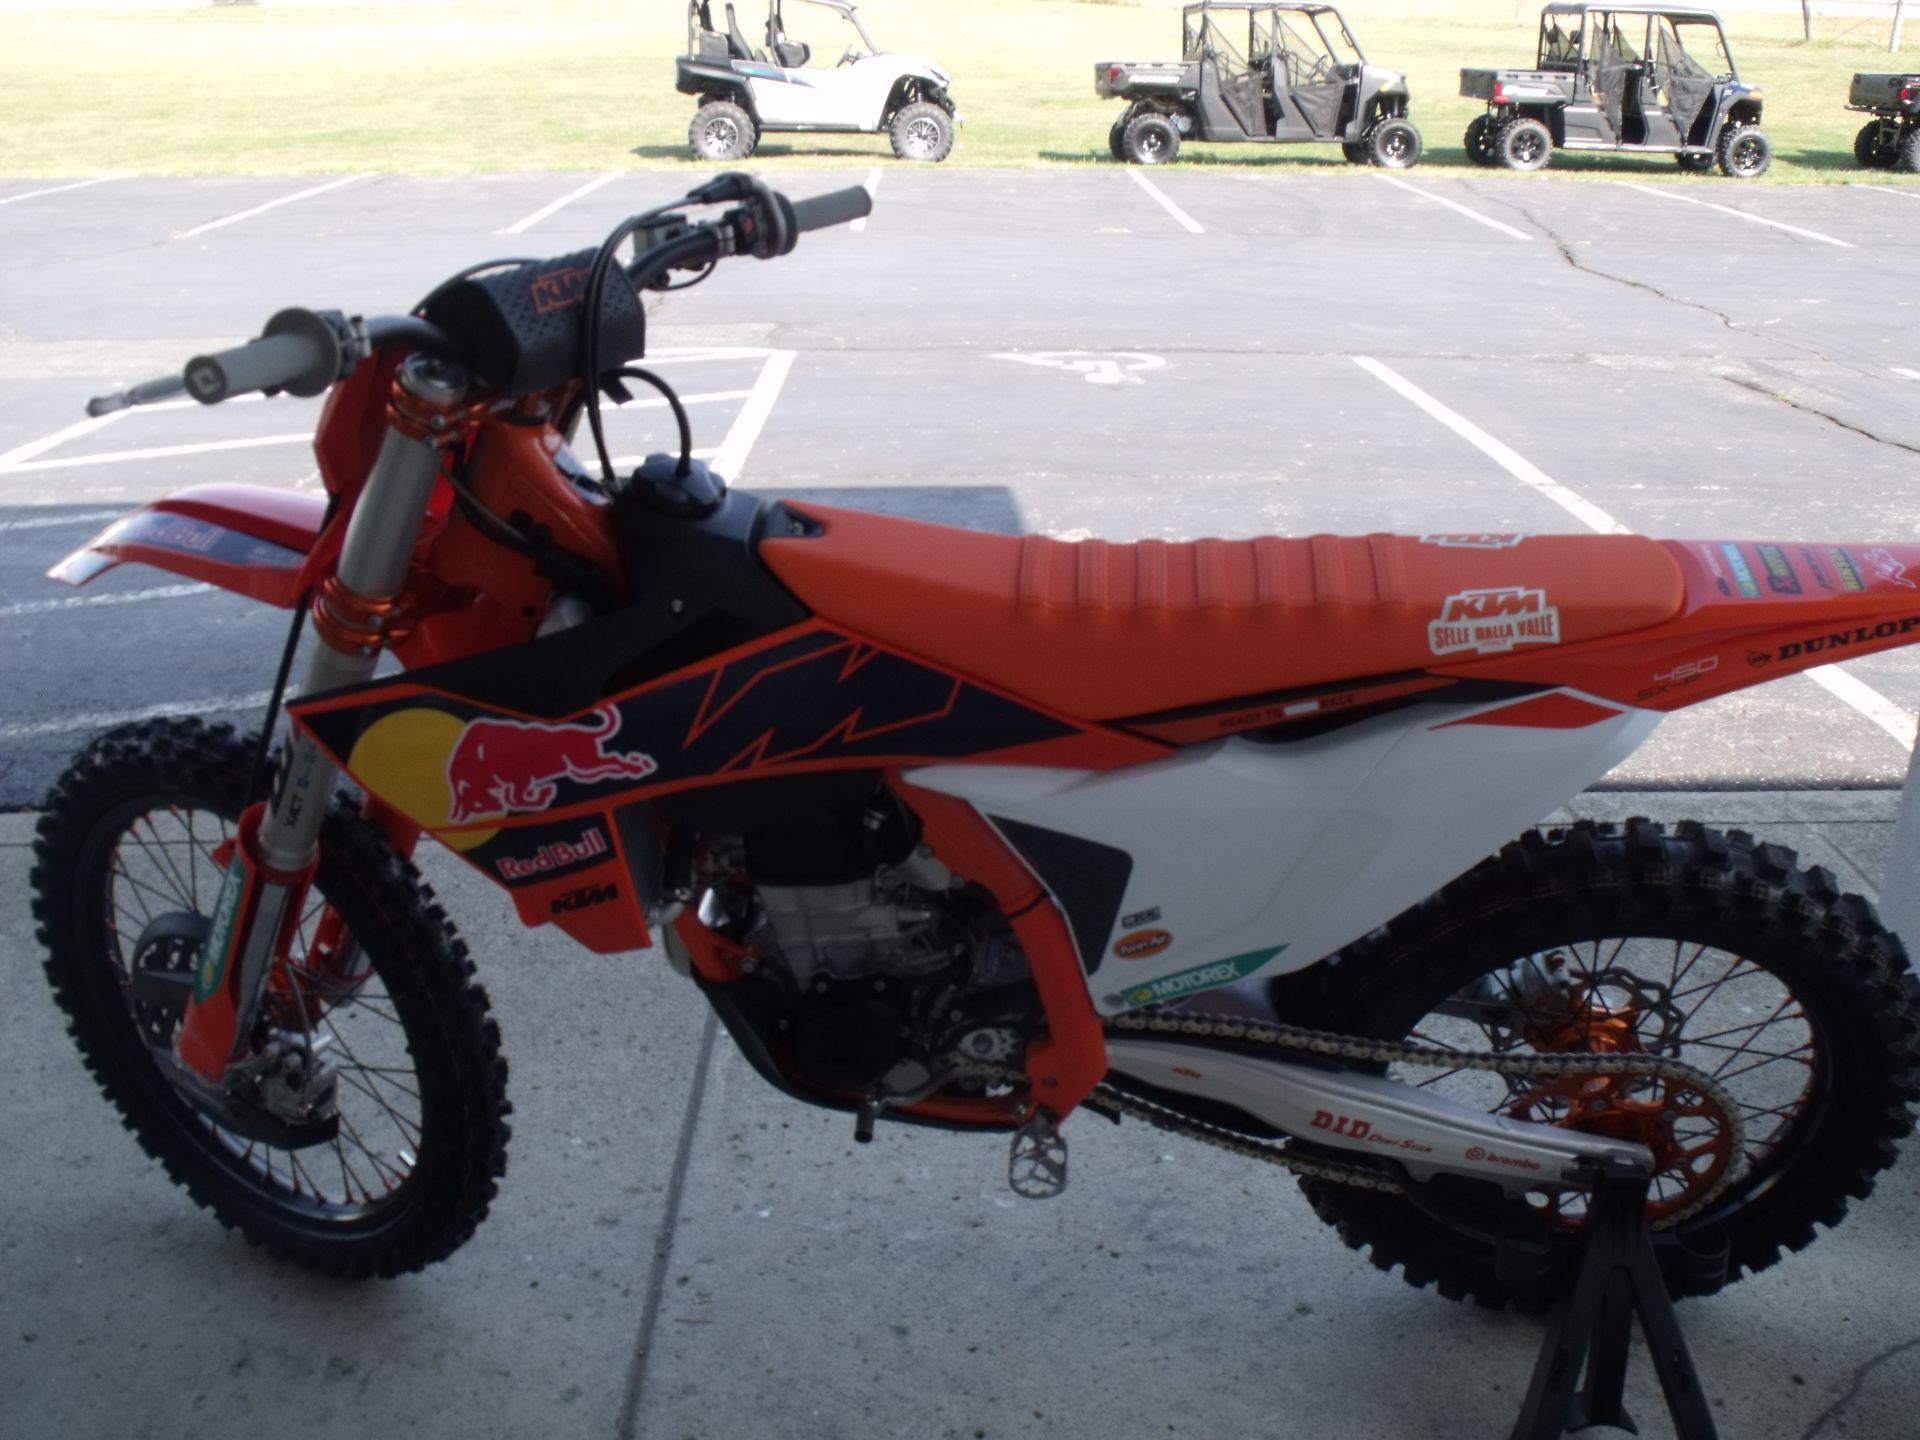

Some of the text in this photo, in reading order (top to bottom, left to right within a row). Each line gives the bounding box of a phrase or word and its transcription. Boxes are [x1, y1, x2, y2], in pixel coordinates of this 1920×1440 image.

[1444, 588, 1543, 623] KTM
[1435, 615, 1553, 648] SELLE DALLA VALLE
[1779, 616, 1920, 661] DUNLOP
[1654, 656, 1718, 681] 450
[496, 827, 607, 880] Red Bull
[551, 882, 617, 914] KTM
[1152, 963, 1240, 996] MOTOREX
[1487, 1152, 1540, 1170] brembo
